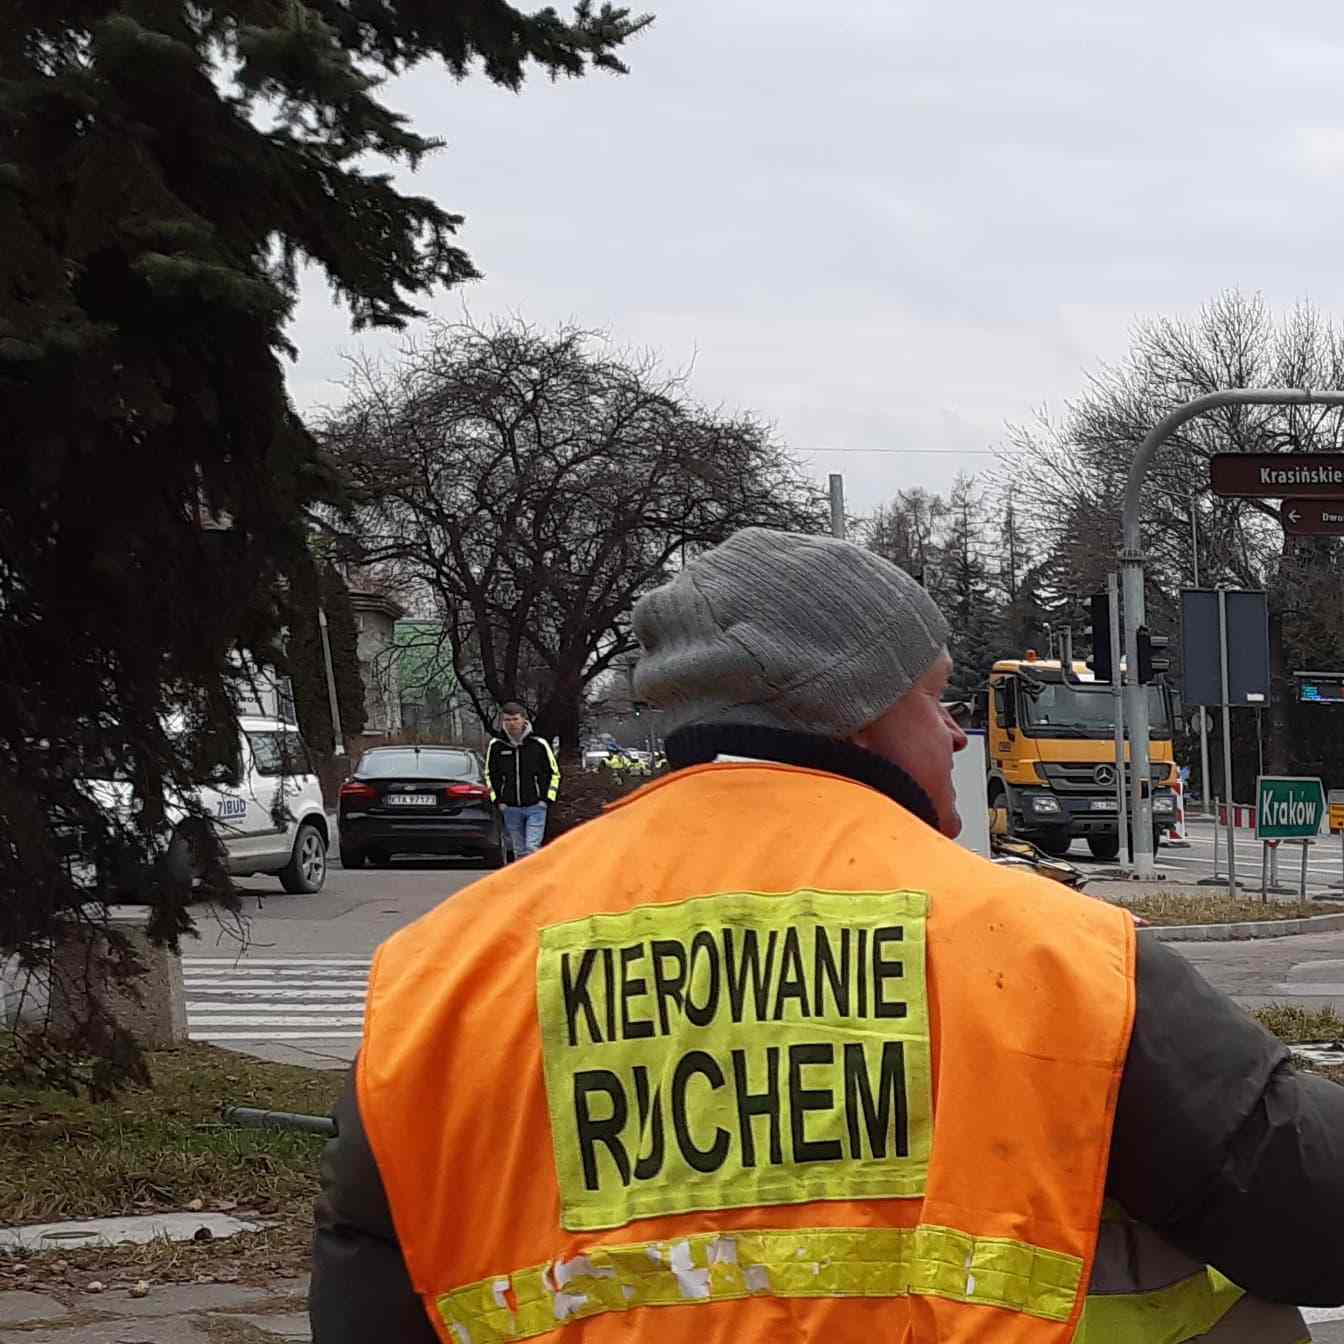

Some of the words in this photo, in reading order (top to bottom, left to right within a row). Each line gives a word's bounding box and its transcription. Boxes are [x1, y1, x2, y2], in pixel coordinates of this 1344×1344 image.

[1262, 790, 1316, 825] Kraków
[559, 924, 909, 1047] KIEROWANIE
[573, 1040, 910, 1192] RUCHEM
